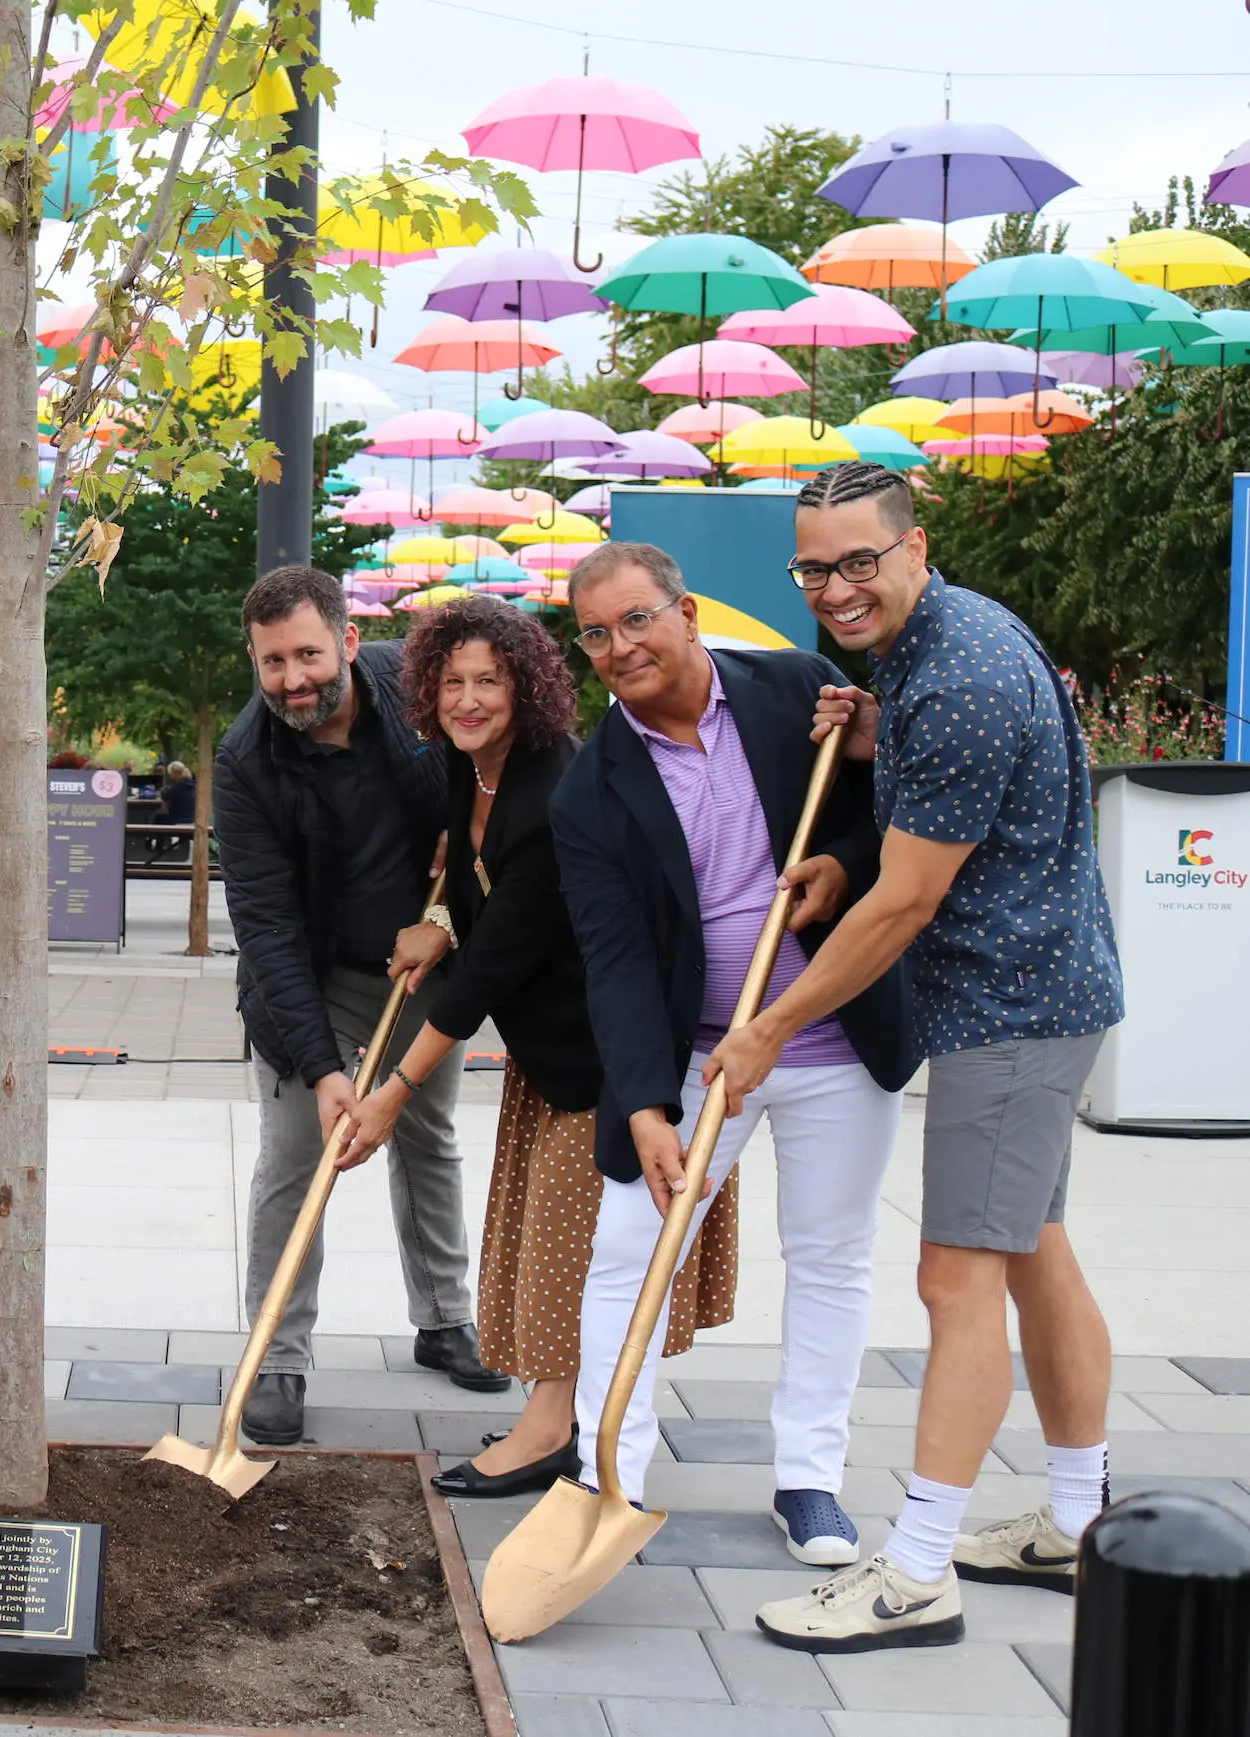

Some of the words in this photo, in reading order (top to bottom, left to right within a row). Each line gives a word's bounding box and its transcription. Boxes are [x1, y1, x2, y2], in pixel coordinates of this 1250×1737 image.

[1146, 870, 1212, 888] Langley
[1214, 870, 1248, 888] City
[2, 1535, 36, 1544] jointly
[36, 1547, 59, 1555] City
[26, 1556, 55, 1564] 2025,
[9, 1574, 49, 1583] Nations
[6, 1594, 46, 1603] peoples
[25, 1605, 45, 1613] and
